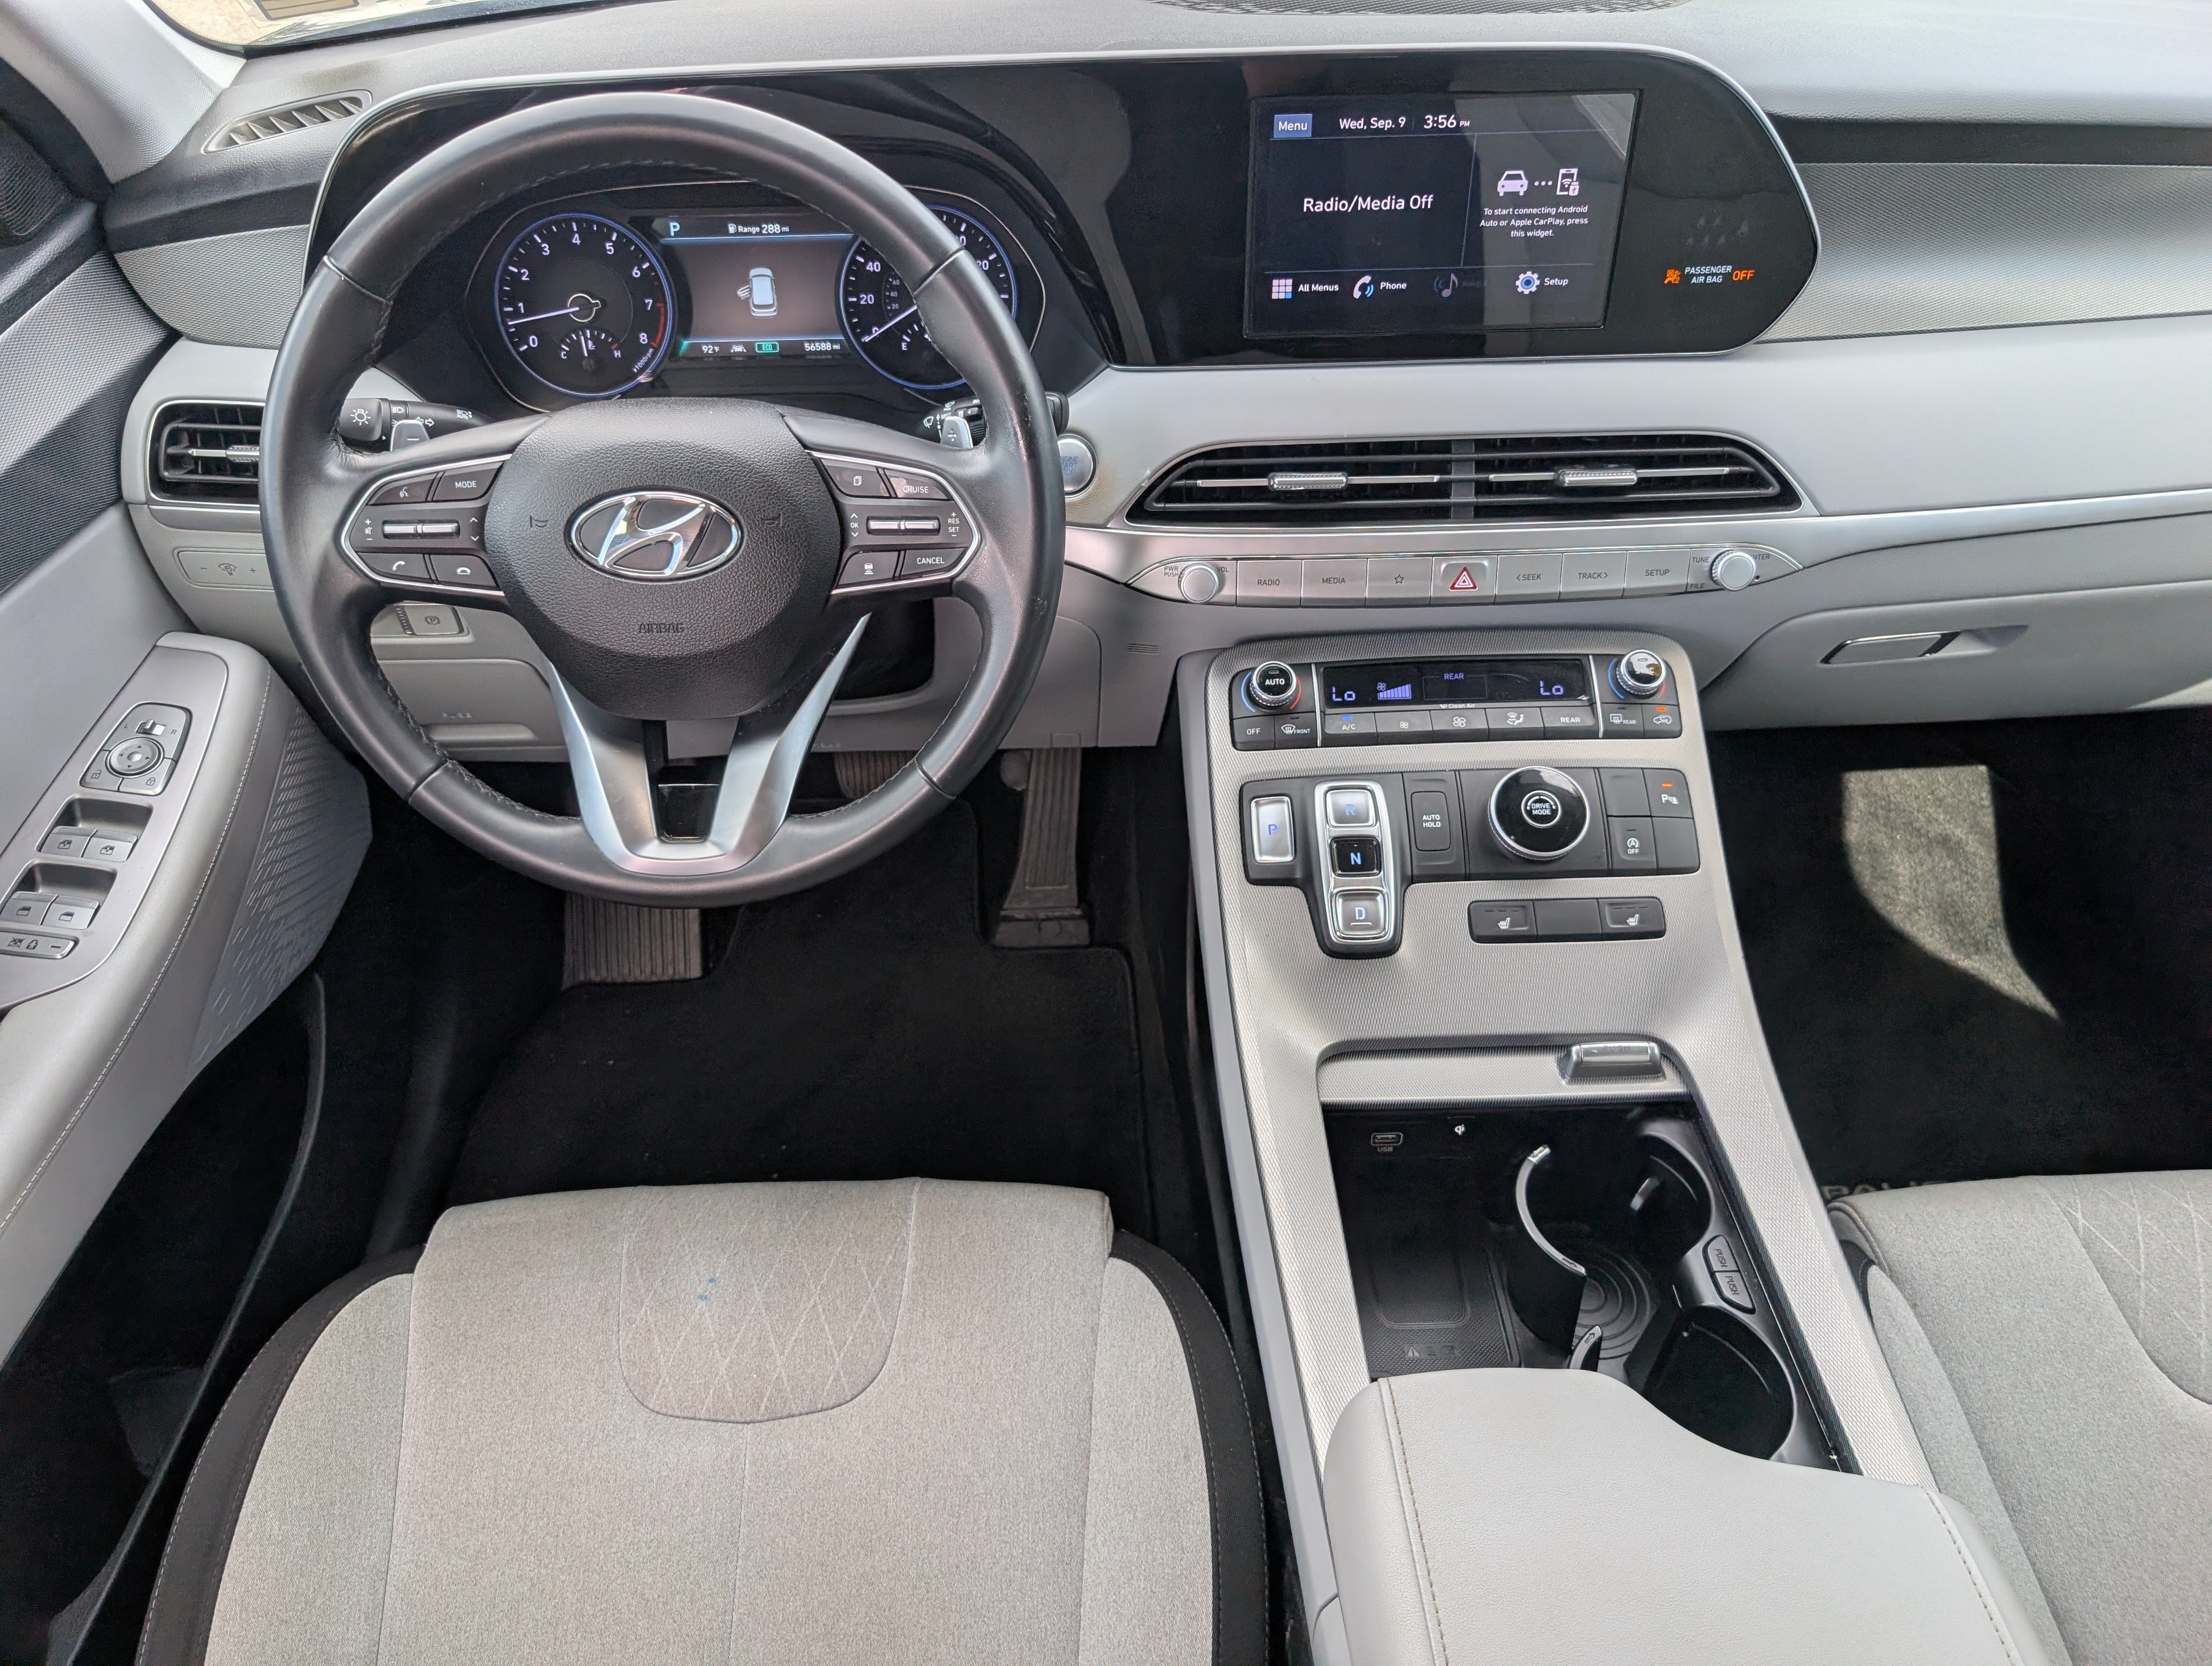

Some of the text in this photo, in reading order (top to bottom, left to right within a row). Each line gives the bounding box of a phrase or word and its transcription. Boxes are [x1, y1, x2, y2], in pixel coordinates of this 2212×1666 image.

[1278, 121, 1307, 131] Menu
[1339, 117, 1406, 130] Wed, Sep. 9
[1424, 114, 1456, 129] 3:56
[1303, 194, 1433, 212] Radio/Media Off
[1514, 207, 1556, 215] connecting
[1558, 205, 1588, 213] Android
[1510, 219, 1532, 227] Apple
[1567, 217, 1588, 226] press
[669, 222, 680, 236] P
[762, 224, 781, 234] 288
[1527, 229, 1554, 238] widget.
[572, 233, 581, 245] 4
[542, 244, 550, 255] 3
[605, 243, 614, 254] 5
[632, 266, 640, 277] 6
[866, 261, 881, 272] 40
[1684, 265, 1732, 274] PASSENGER
[521, 269, 530, 280] 2
[1733, 270, 1755, 281] OFF
[1544, 278, 1568, 286] Setup
[645, 299, 652, 310] 7
[860, 294, 874, 304] 20
[518, 303, 524, 313] 1
[529, 335, 538, 347] 0
[640, 333, 647, 344] 8
[805, 343, 832, 351] 56588
[902, 343, 908, 351] E
[455, 480, 477, 489] MODE
[1644, 569, 1669, 577] SETUP
[638, 623, 685, 633] AIRBAG
[1332, 686, 1355, 701] Lo
[1540, 681, 1564, 696] Lo
[1345, 804, 1355, 816] R
[1268, 824, 1277, 836] P
[1350, 853, 1361, 865] N
[1355, 907, 1366, 920] D
[1714, 1248, 1728, 1267] PUSH
[1725, 1276, 1739, 1295] PUSH
